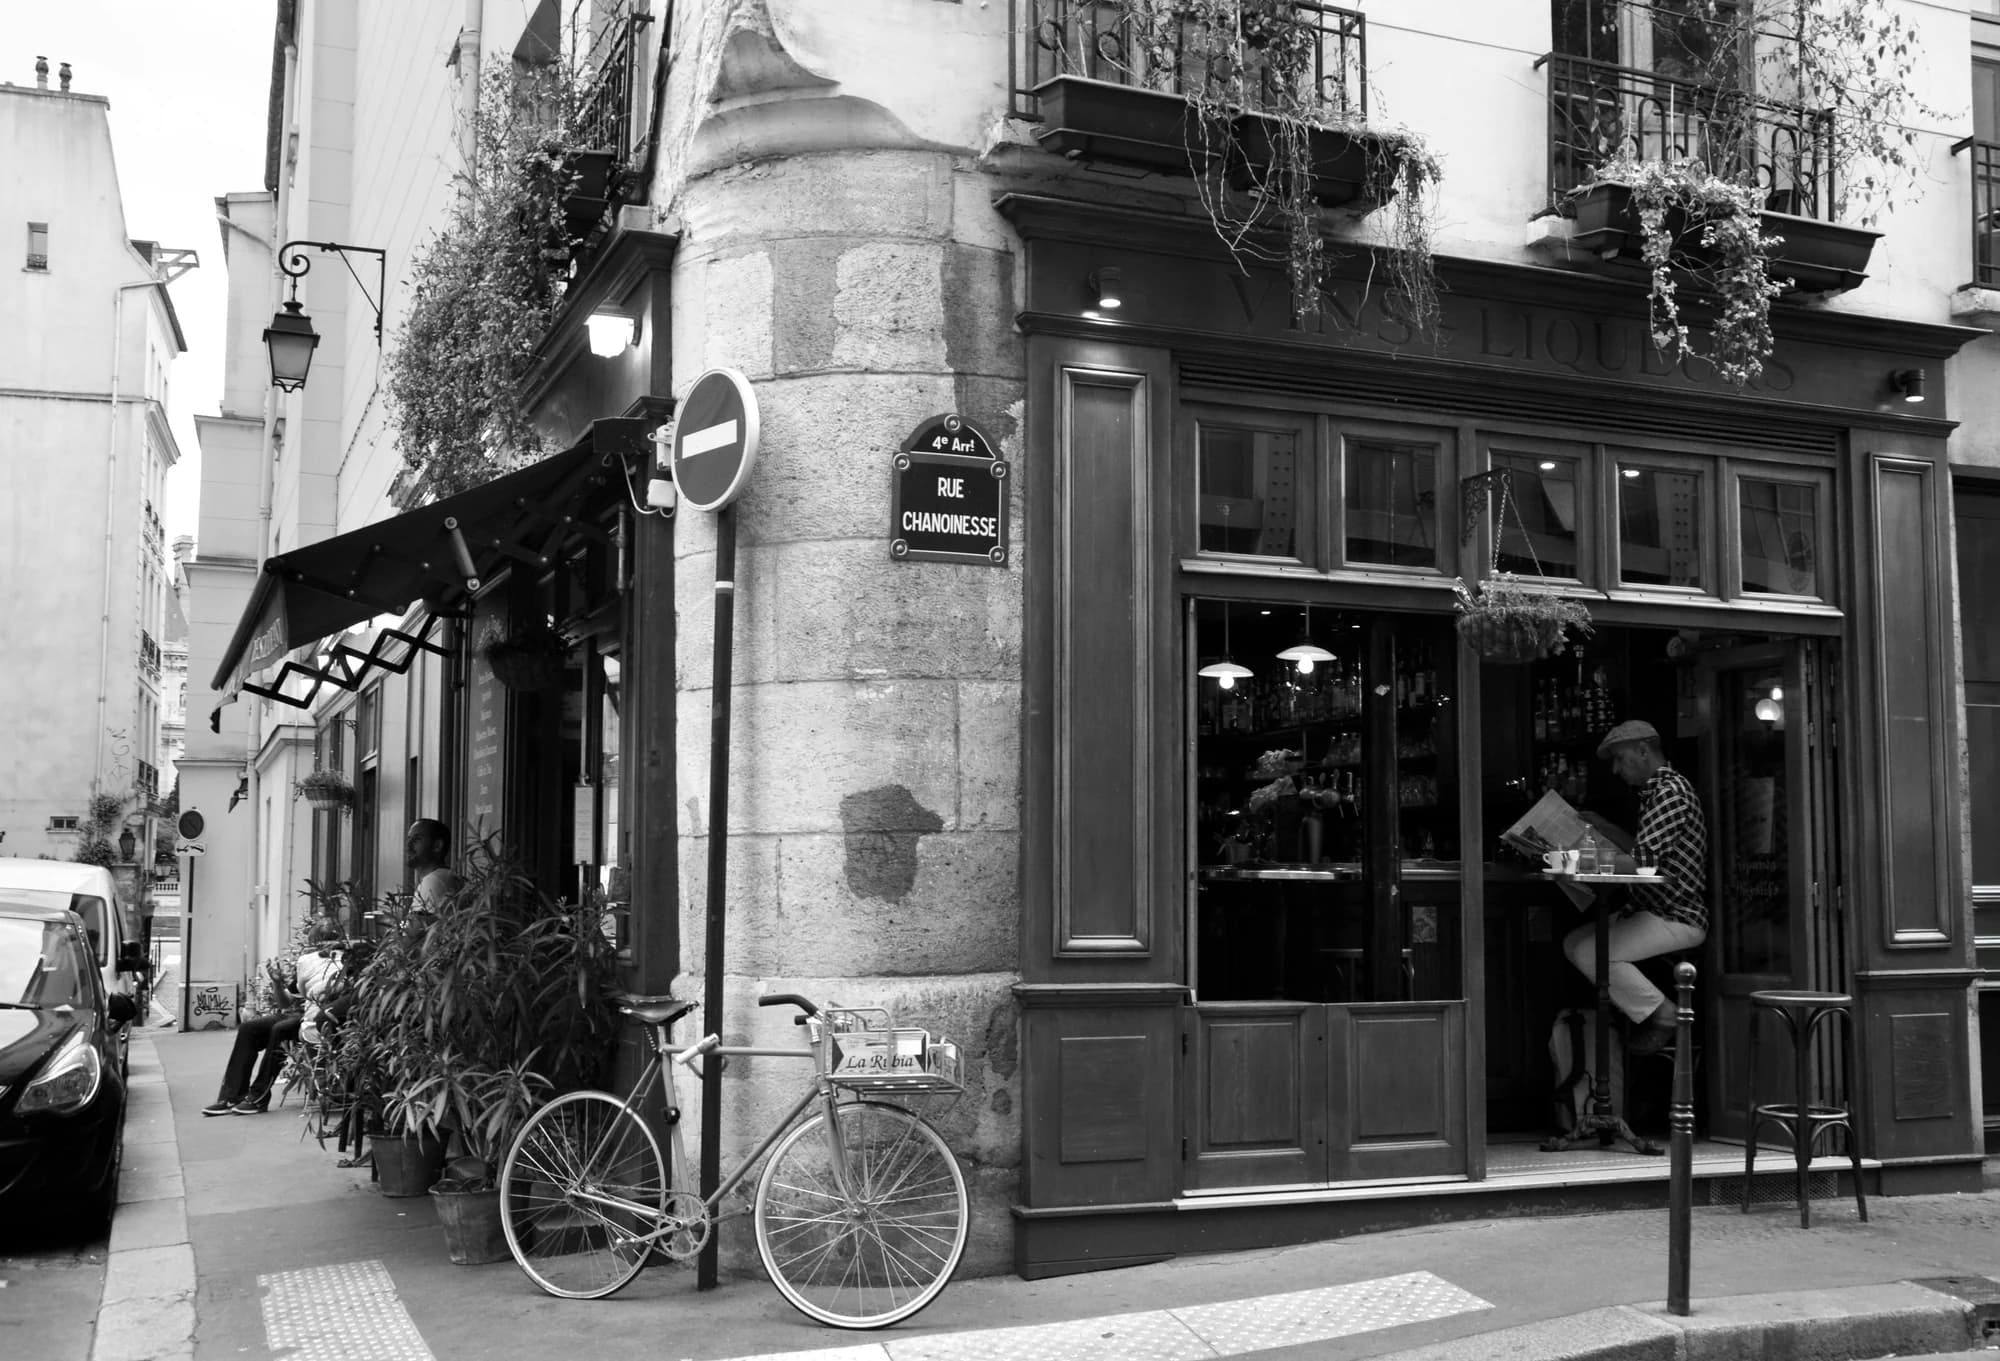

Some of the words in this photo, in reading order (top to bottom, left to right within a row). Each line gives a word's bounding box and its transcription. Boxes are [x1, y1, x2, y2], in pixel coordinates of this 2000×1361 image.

[1226, 273, 1413, 345] VINS
[1477, 308, 1795, 392] LIQUEUS
[932, 435, 949, 450] 4e
[937, 477, 965, 498] RUE
[902, 511, 997, 538] CHANOINESSE
[846, 1056, 866, 1068] La
